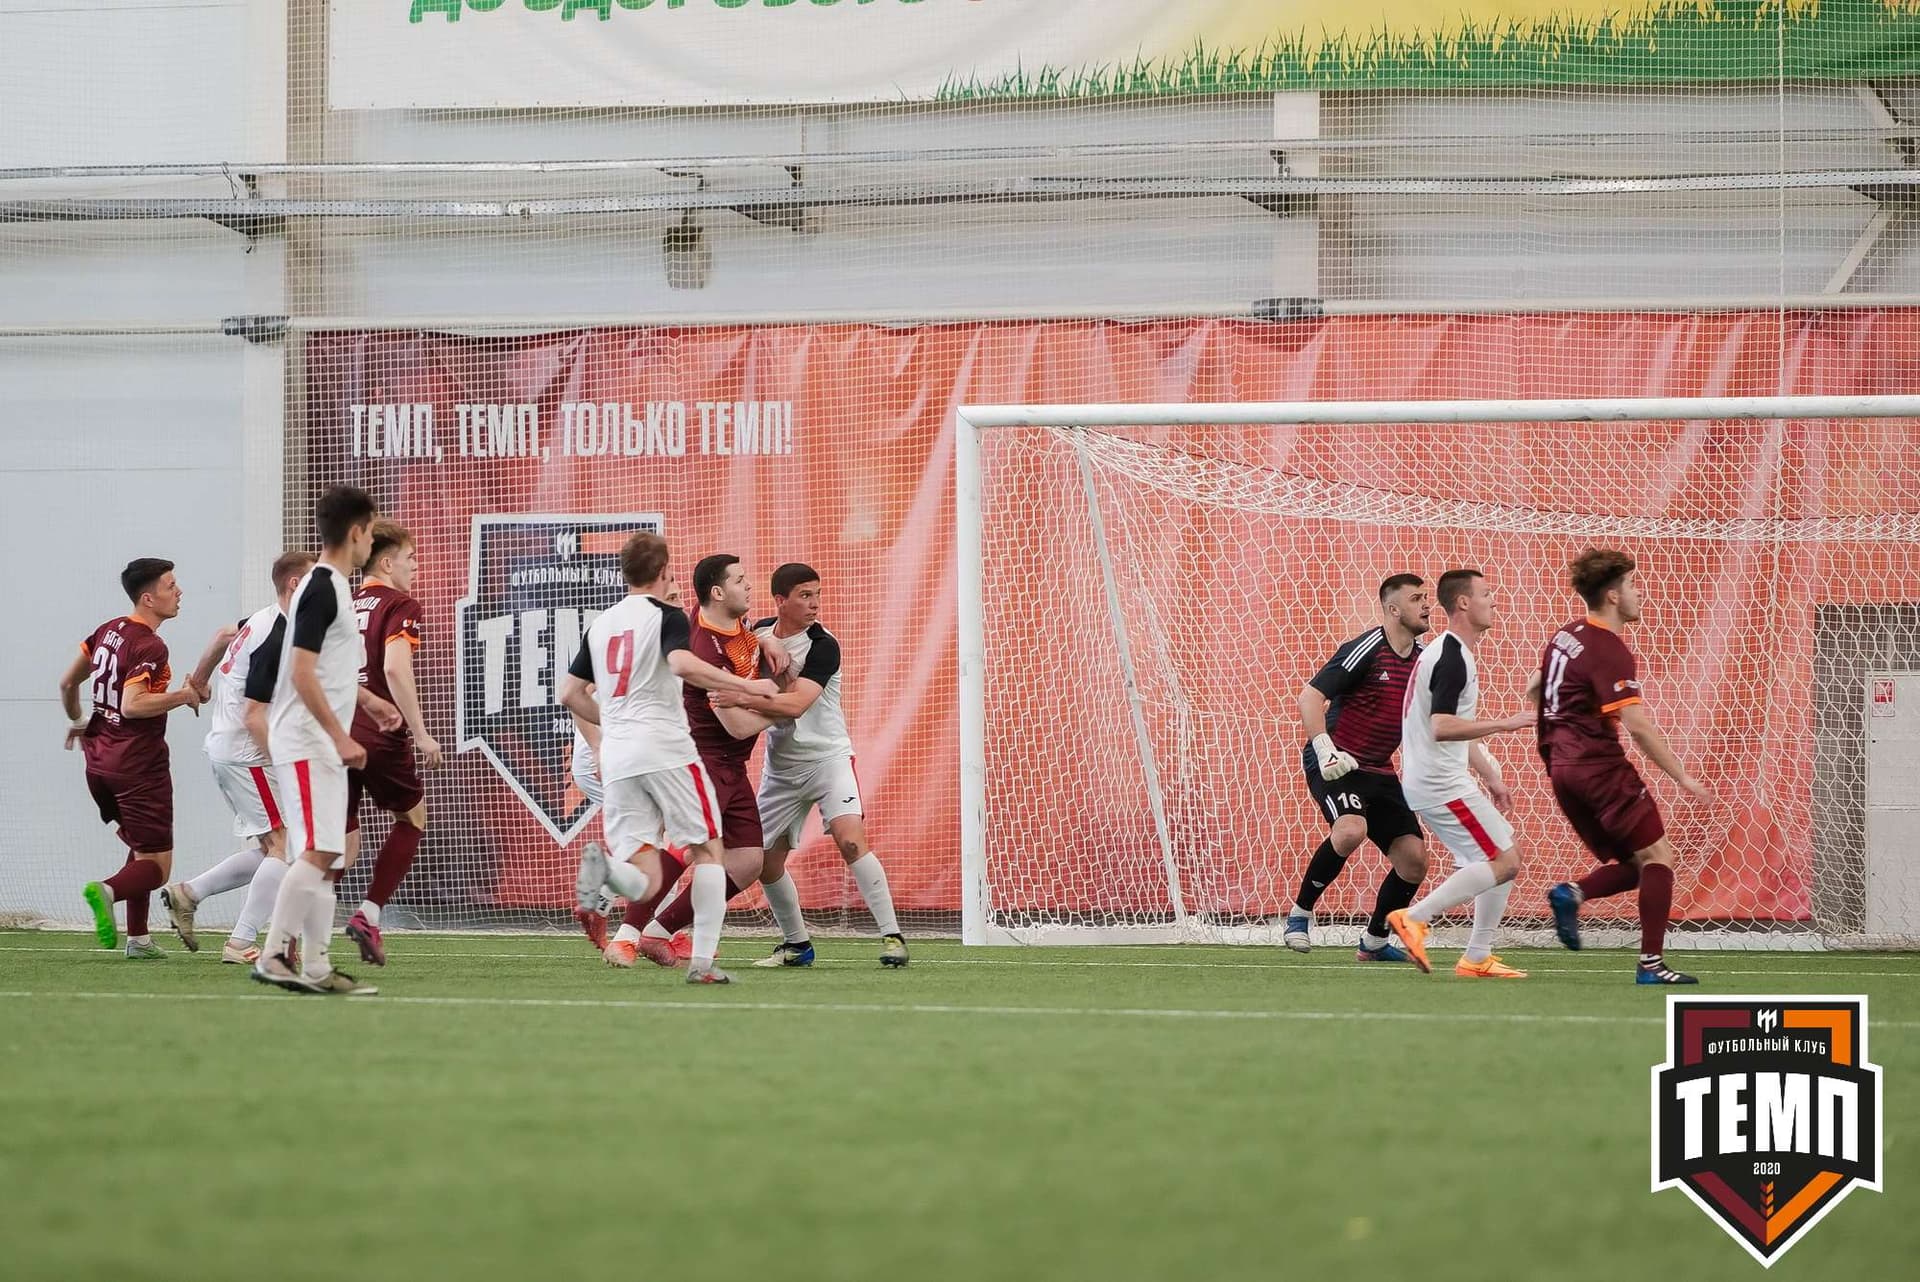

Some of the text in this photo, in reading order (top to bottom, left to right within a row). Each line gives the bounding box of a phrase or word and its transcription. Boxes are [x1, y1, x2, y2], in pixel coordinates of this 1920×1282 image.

[350, 400, 793, 463] ТЕМП, ТЕМП, ТОЛЬКО ТЕМП!
[512, 564, 588, 587] ФУТБОЛЬНЫЙ
[90, 646, 118, 709] 21
[605, 629, 634, 698] 9
[1337, 792, 1362, 810] 16
